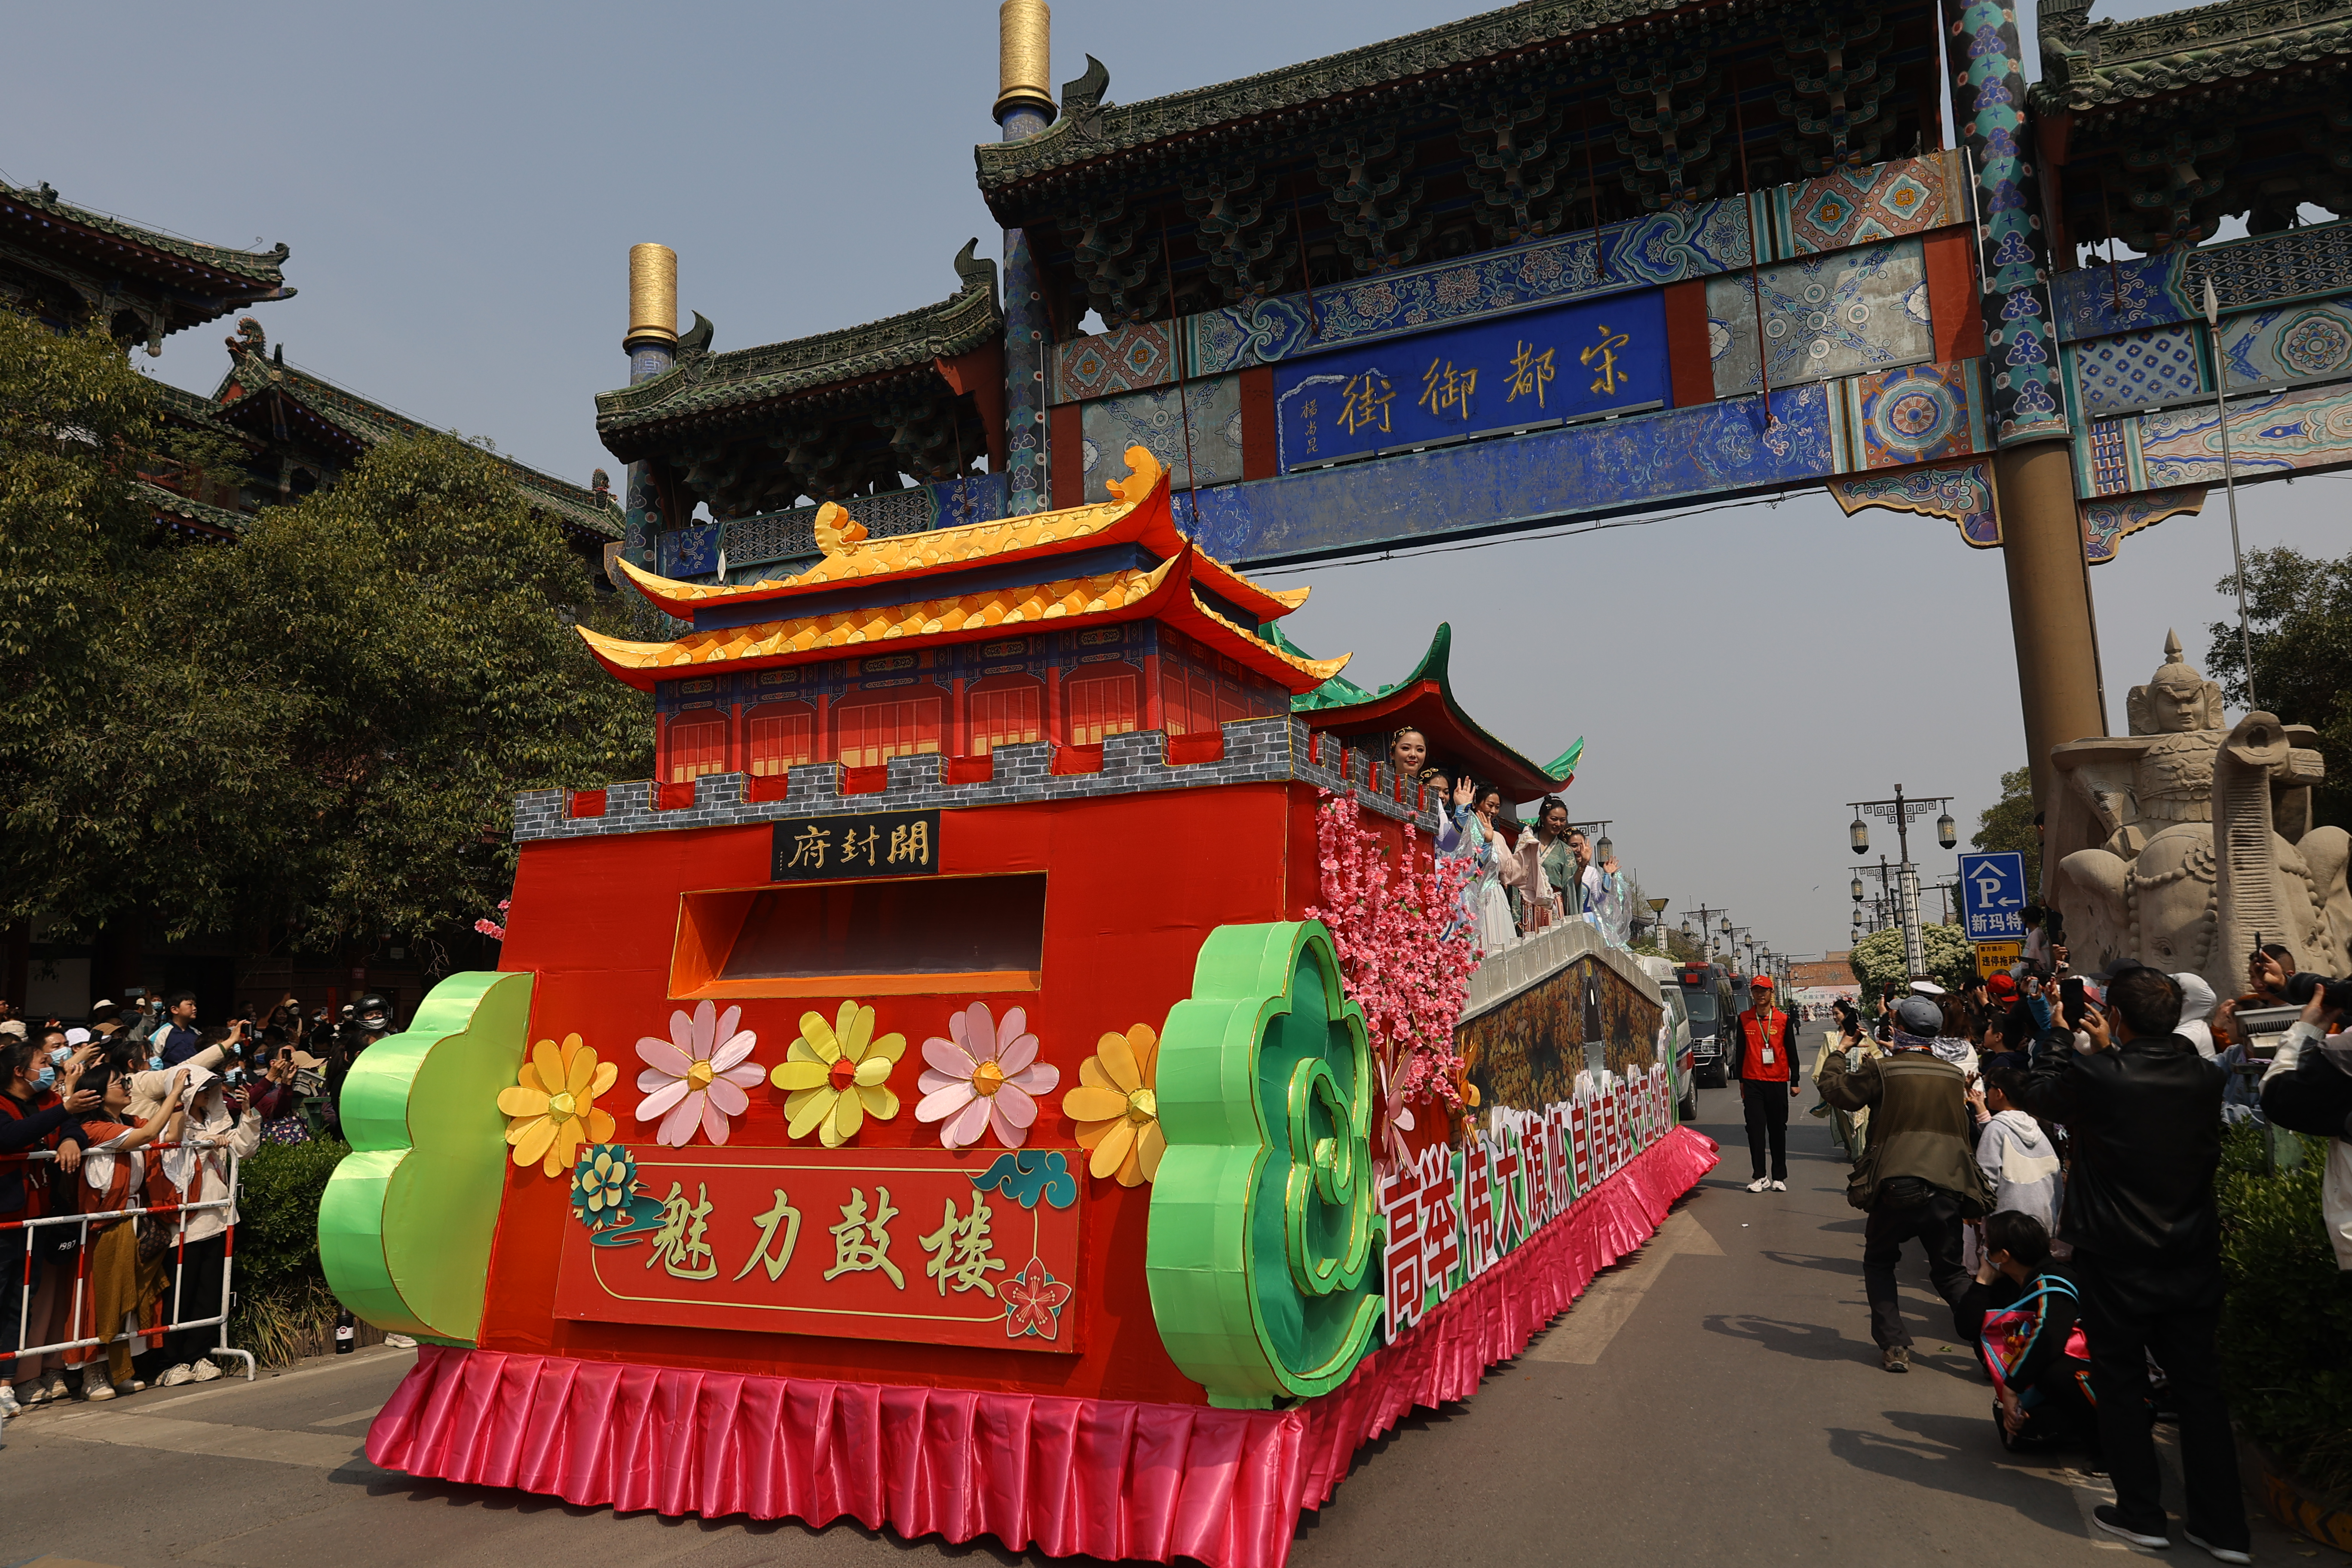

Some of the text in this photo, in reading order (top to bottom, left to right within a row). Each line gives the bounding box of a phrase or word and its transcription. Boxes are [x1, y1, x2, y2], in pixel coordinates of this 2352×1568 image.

[1337, 325, 1630, 436] 宋都御街
[1300, 398, 1318, 454] 楊尚昆
[788, 821, 929, 869] 開封府
[1976, 878, 2001, 908] P
[1971, 912, 2022, 932] 新玛特
[58, 1239, 77, 1251] 1987
[645, 1181, 1005, 1298] 魅力鼓楼
